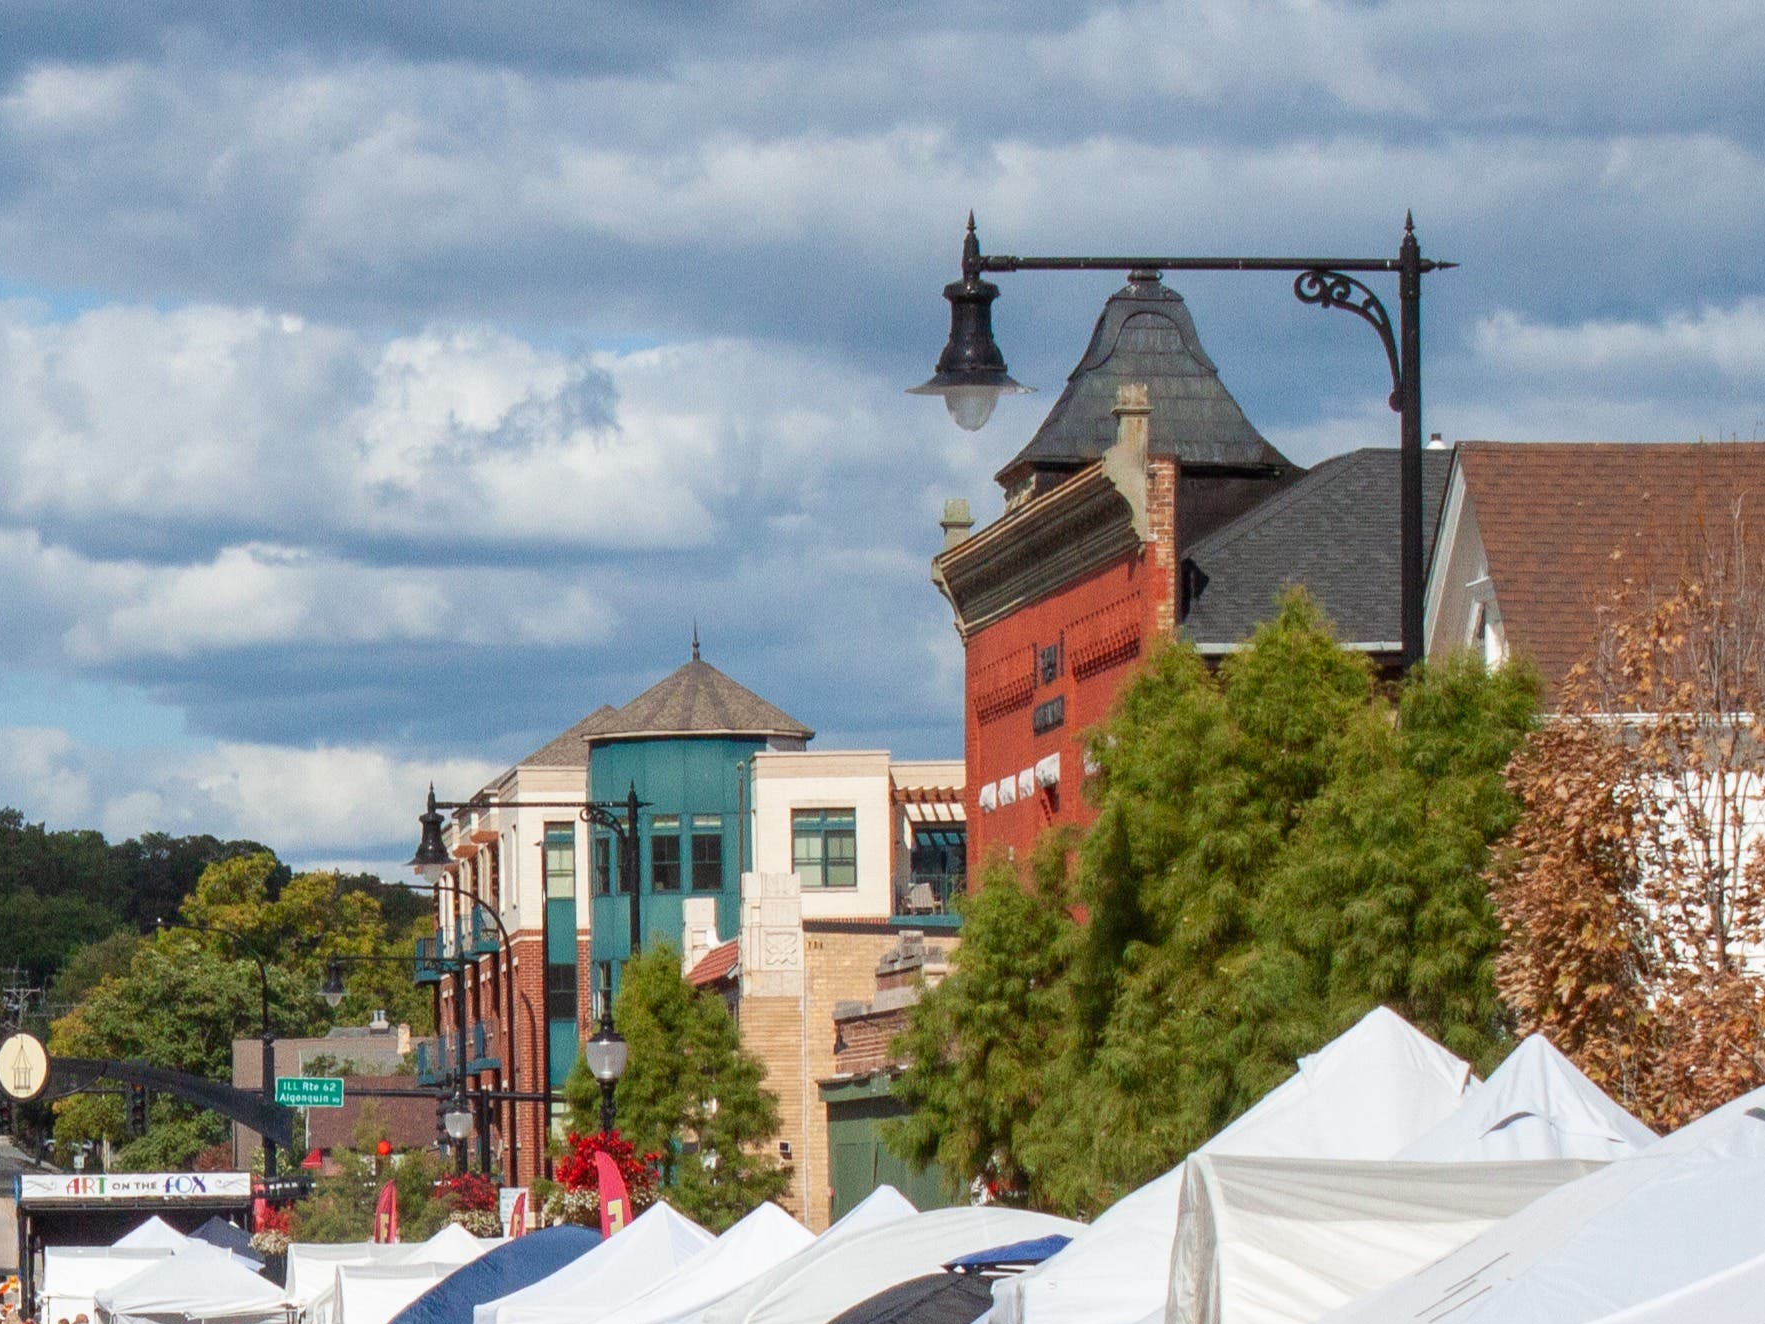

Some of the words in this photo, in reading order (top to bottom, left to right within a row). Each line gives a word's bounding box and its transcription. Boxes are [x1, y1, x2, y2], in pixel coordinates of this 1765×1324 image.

[283, 1081, 298, 1091] ILL
[302, 1081, 319, 1092] Rte
[323, 1082, 337, 1092] 62
[279, 1092, 329, 1104] Algonquin
[66, 1176, 108, 1195] ART
[112, 1181, 130, 1190] ON
[135, 1181, 157, 1190] THE
[163, 1175, 207, 1194] FOX
